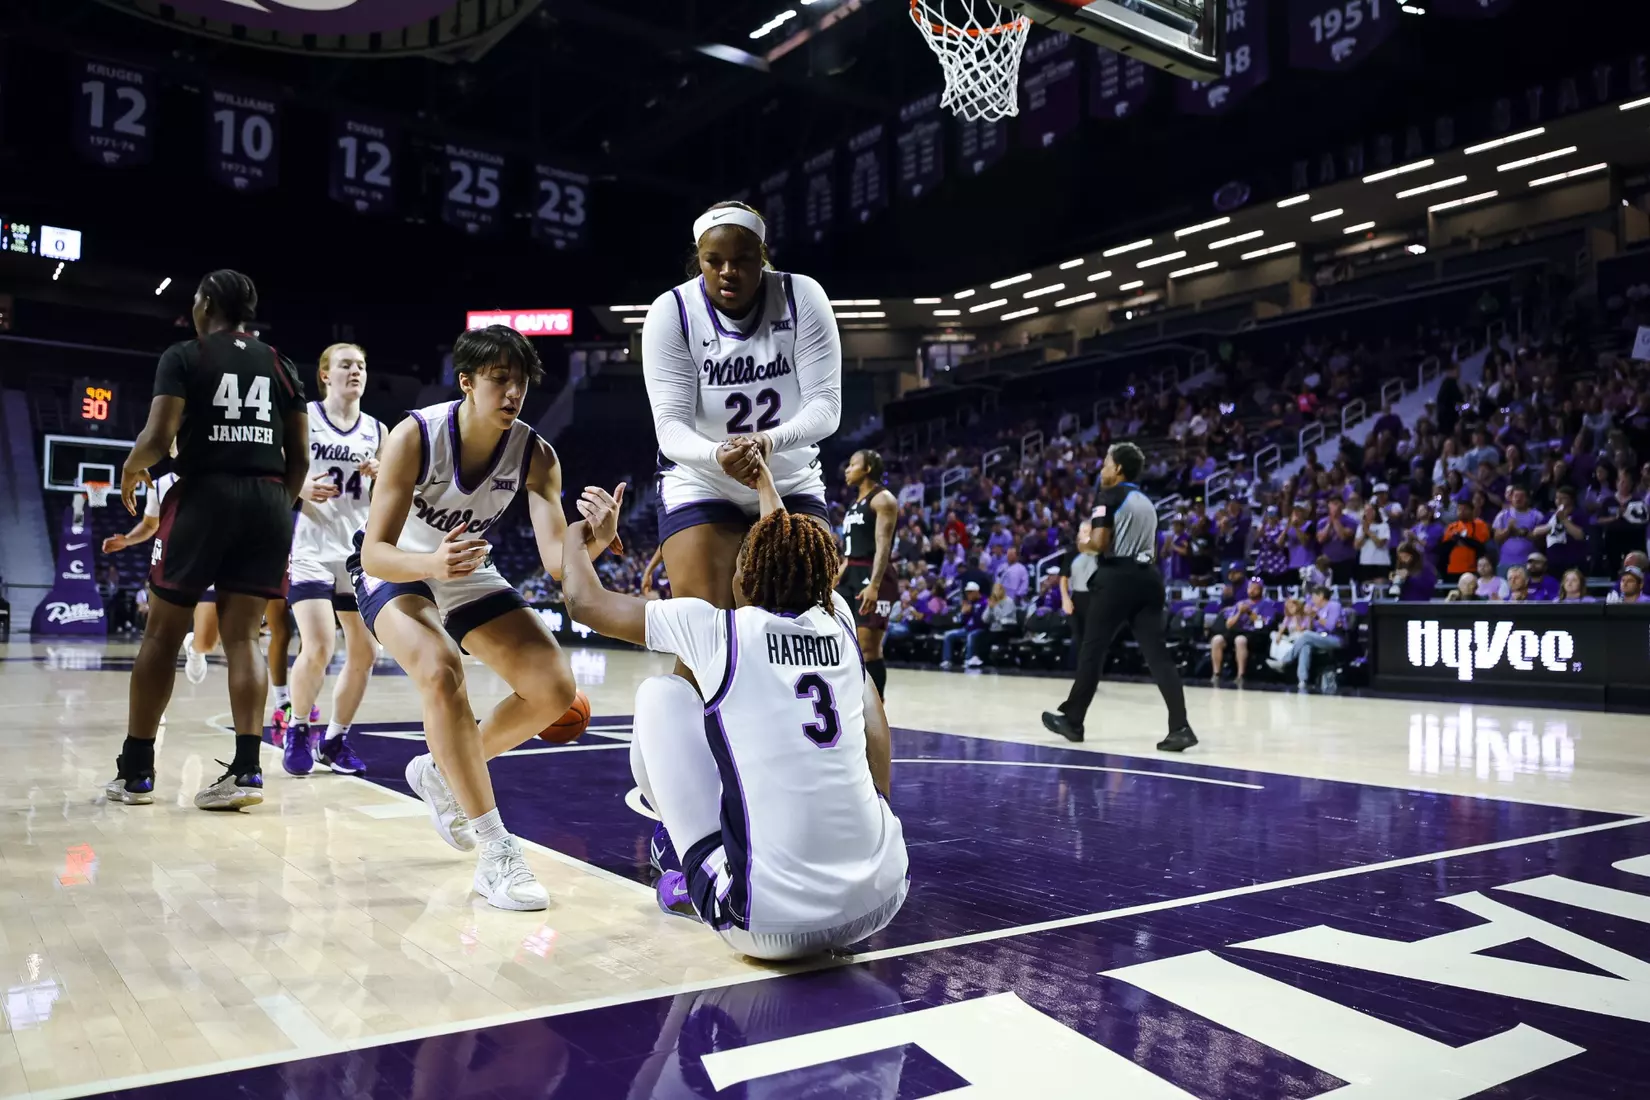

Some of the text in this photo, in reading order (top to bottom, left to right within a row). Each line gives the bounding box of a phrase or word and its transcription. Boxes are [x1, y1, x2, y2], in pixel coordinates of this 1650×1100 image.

[1309, 0, 1380, 43] 1951
[86, 63, 143, 85] KRUGER
[81, 79, 147, 137] 12
[213, 90, 276, 115] WILLIAMS
[213, 109, 273, 162] 10
[337, 135, 392, 187] 12
[448, 160, 501, 209] 25
[537, 179, 587, 227] 23
[703, 355, 791, 386] Wildcats
[82, 398, 108, 420] 30
[213, 372, 273, 422] 44
[724, 387, 781, 434] 22
[208, 425, 274, 445] JANNEH
[327, 466, 362, 500] 34
[766, 632, 840, 668] HARROD
[794, 671, 842, 749] 3
